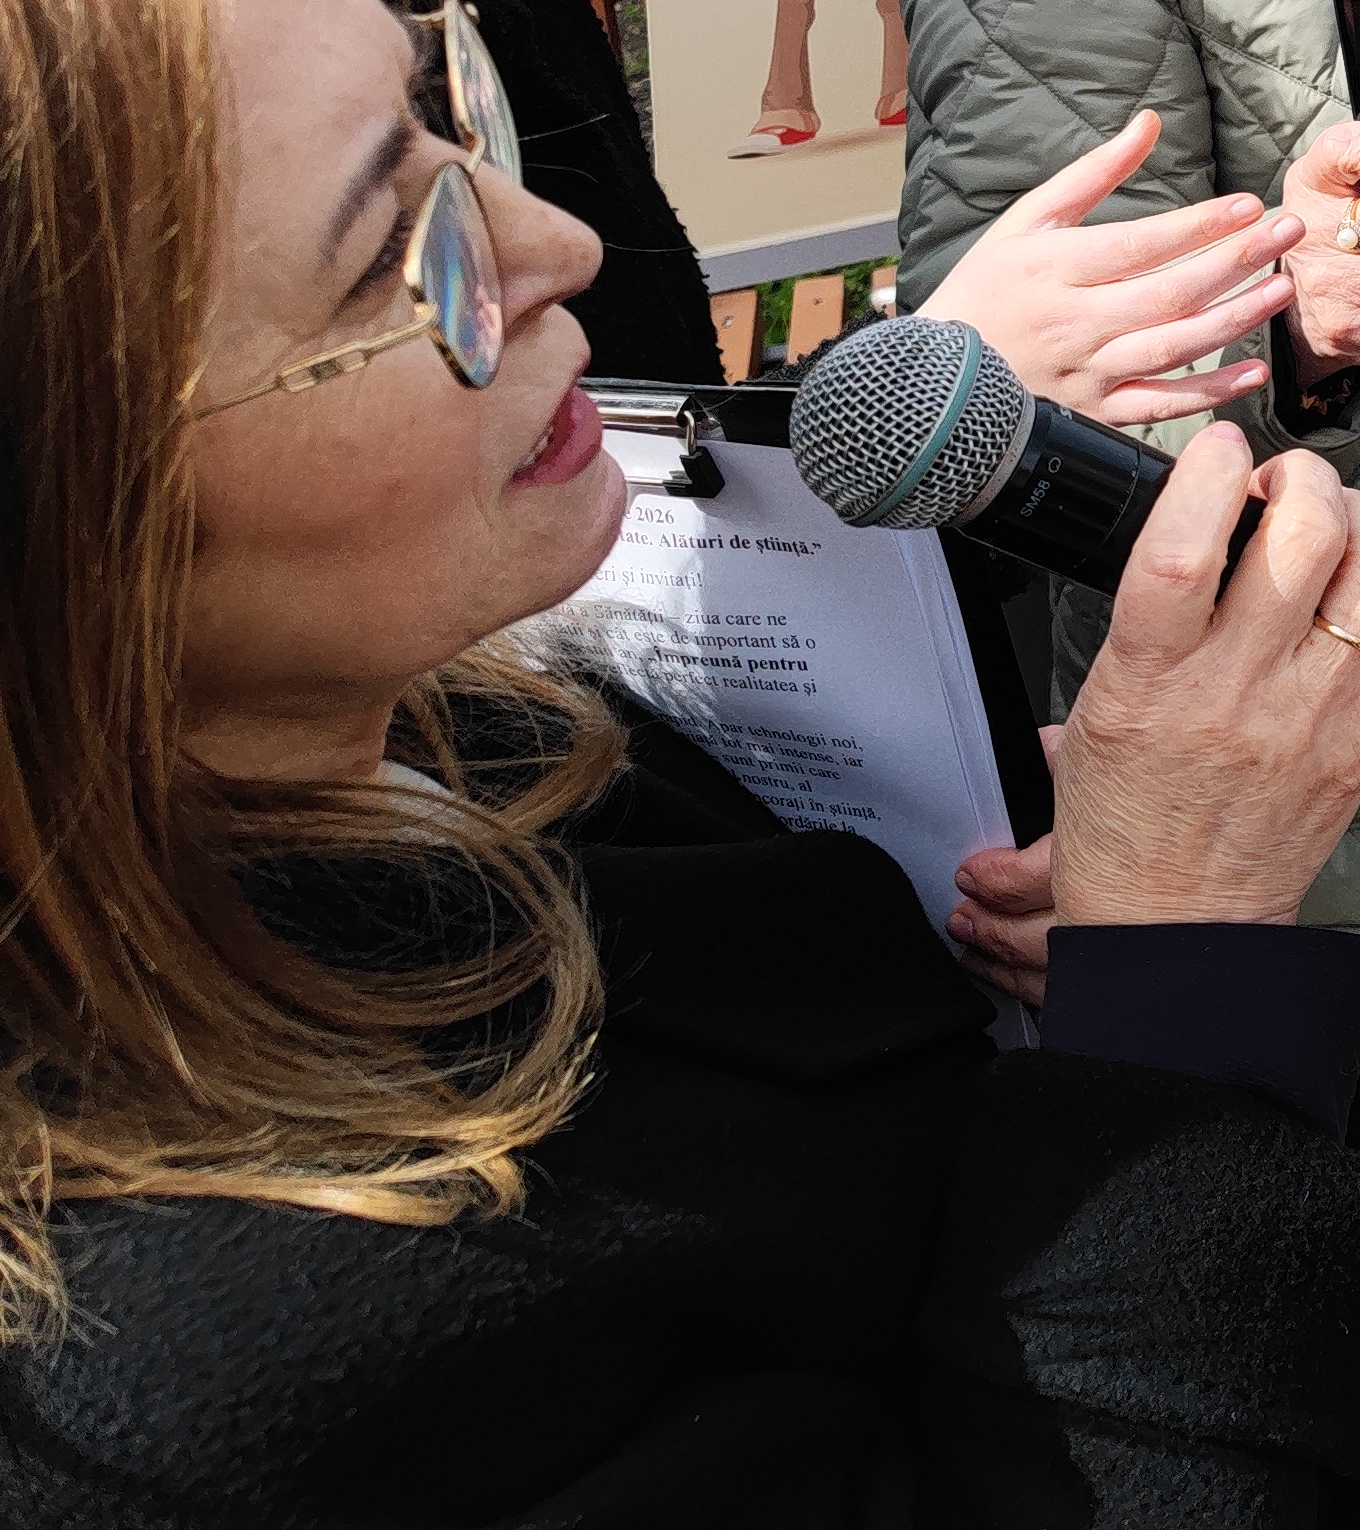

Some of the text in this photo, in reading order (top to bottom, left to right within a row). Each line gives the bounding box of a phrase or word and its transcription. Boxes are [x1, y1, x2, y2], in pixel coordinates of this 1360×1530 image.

[1020, 479, 1051, 518] SM58
[635, 506, 674, 524] 2026
[659, 533, 723, 549] Alături
[730, 535, 750, 549] de
[686, 610, 720, 625] ziua
[725, 614, 762, 626] care
[767, 615, 787, 626] ne
[670, 630, 690, 645] de
[694, 634, 776, 651] important
[782, 635, 800, 650] să
[805, 638, 816, 650] o
[747, 658, 809, 673] pentru
[723, 676, 798, 693] realitatea
[709, 719, 743, 733] Apar
[749, 725, 827, 747] tehnologii
[831, 736, 864, 752] noi,
[721, 737, 743, 749] tot
[748, 742, 775, 754] mai
[779, 744, 839, 764] intense,
[844, 753, 864, 768] iar
[722, 754, 755, 767] sunt
[759, 758, 803, 774] primii
[809, 767, 841, 780] care
[742, 773, 813, 793] nostru, al
[808, 797, 825, 812] în
